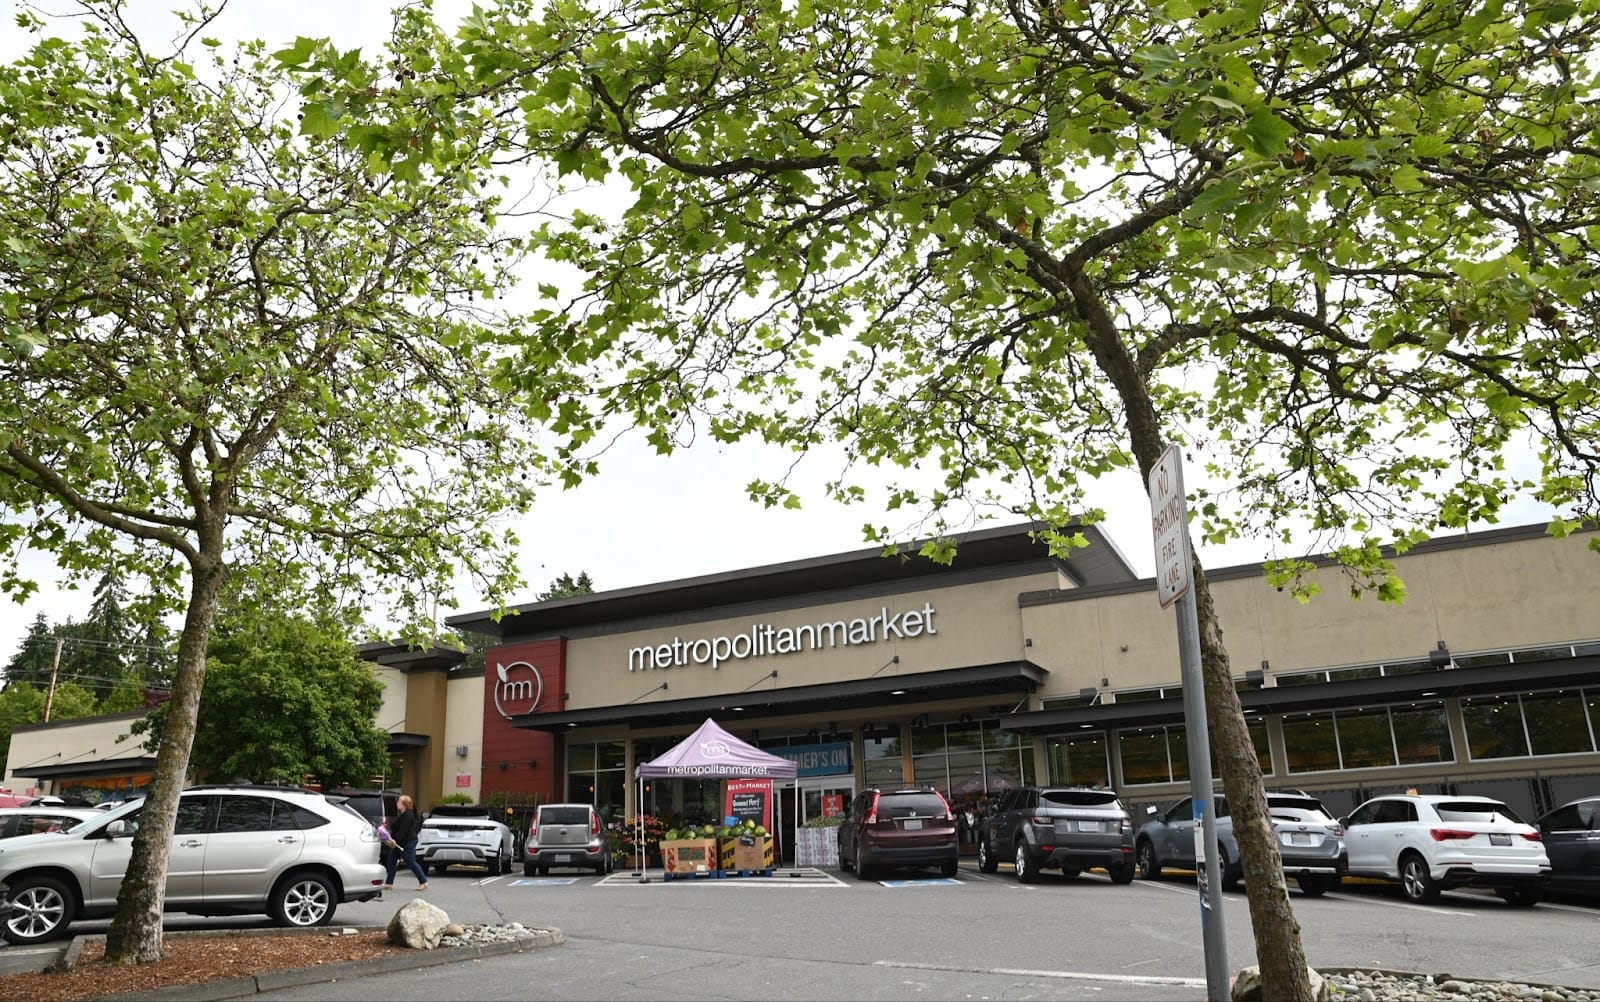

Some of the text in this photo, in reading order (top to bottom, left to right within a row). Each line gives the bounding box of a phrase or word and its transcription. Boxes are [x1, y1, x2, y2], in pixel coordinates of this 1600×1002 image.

[1157, 469, 1169, 501] NO
[1153, 495, 1180, 539] PARKING
[1162, 538, 1177, 563] FIRE
[1164, 562, 1181, 590] LANE
[628, 602, 936, 670] metropolitanmarket
[667, 765, 767, 776] metropolitanmarket
[831, 748, 848, 767] ON
